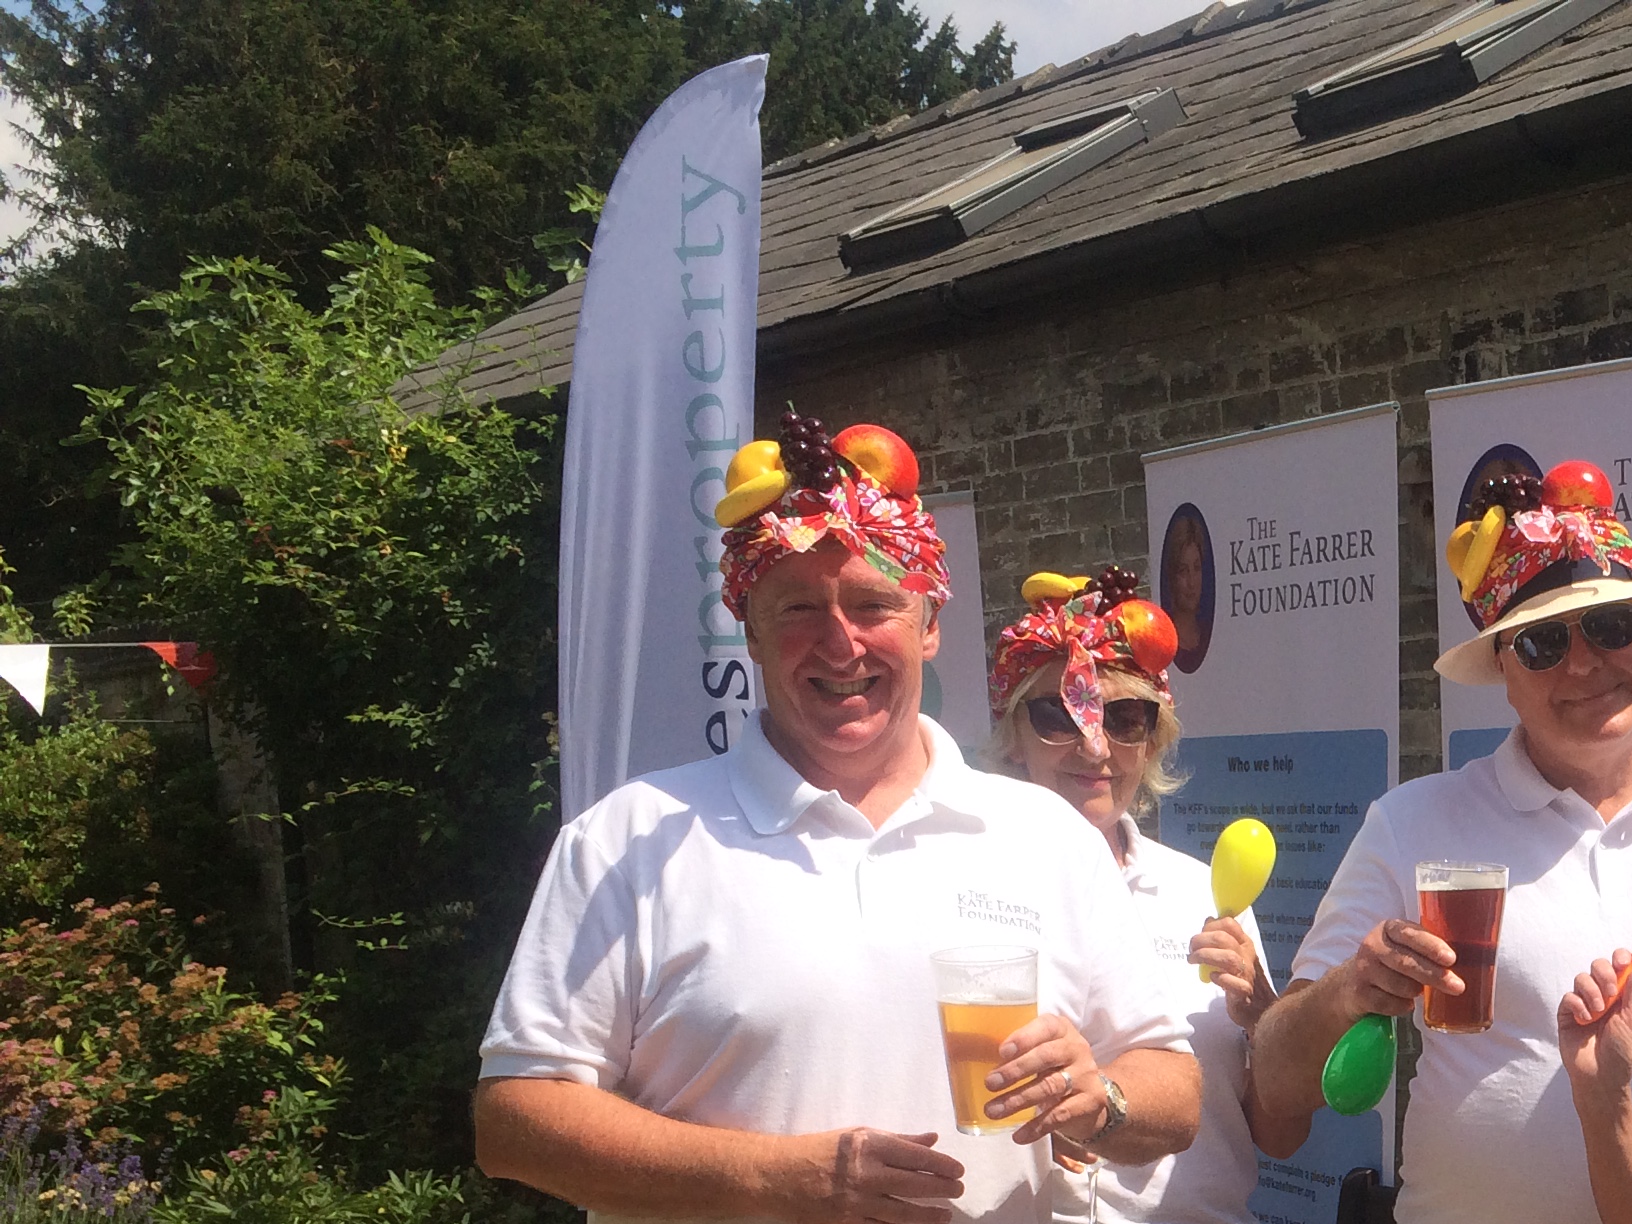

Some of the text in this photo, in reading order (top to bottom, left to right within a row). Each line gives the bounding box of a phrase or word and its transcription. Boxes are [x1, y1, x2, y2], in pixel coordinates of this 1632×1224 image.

[1247, 517, 1277, 541] THE
[1229, 529, 1376, 576] KATE FARRER
[1230, 574, 1376, 618] FOUNDATION
[1228, 754, 1294, 774] Who we help
[1173, 802, 1187, 815] The
[1261, 802, 1274, 815] but
[1276, 805, 1285, 815] we
[1299, 803, 1315, 815] that
[1317, 804, 1333, 815] our
[1335, 801, 1359, 815] funds
[1295, 820, 1318, 834] rather
[1320, 820, 1341, 834] than
[1308, 839, 1326, 853] like:
[957, 893, 994, 911] KATE
[957, 905, 1042, 936] FOUNDATION
[1310, 1171, 1336, 1188] pledge
